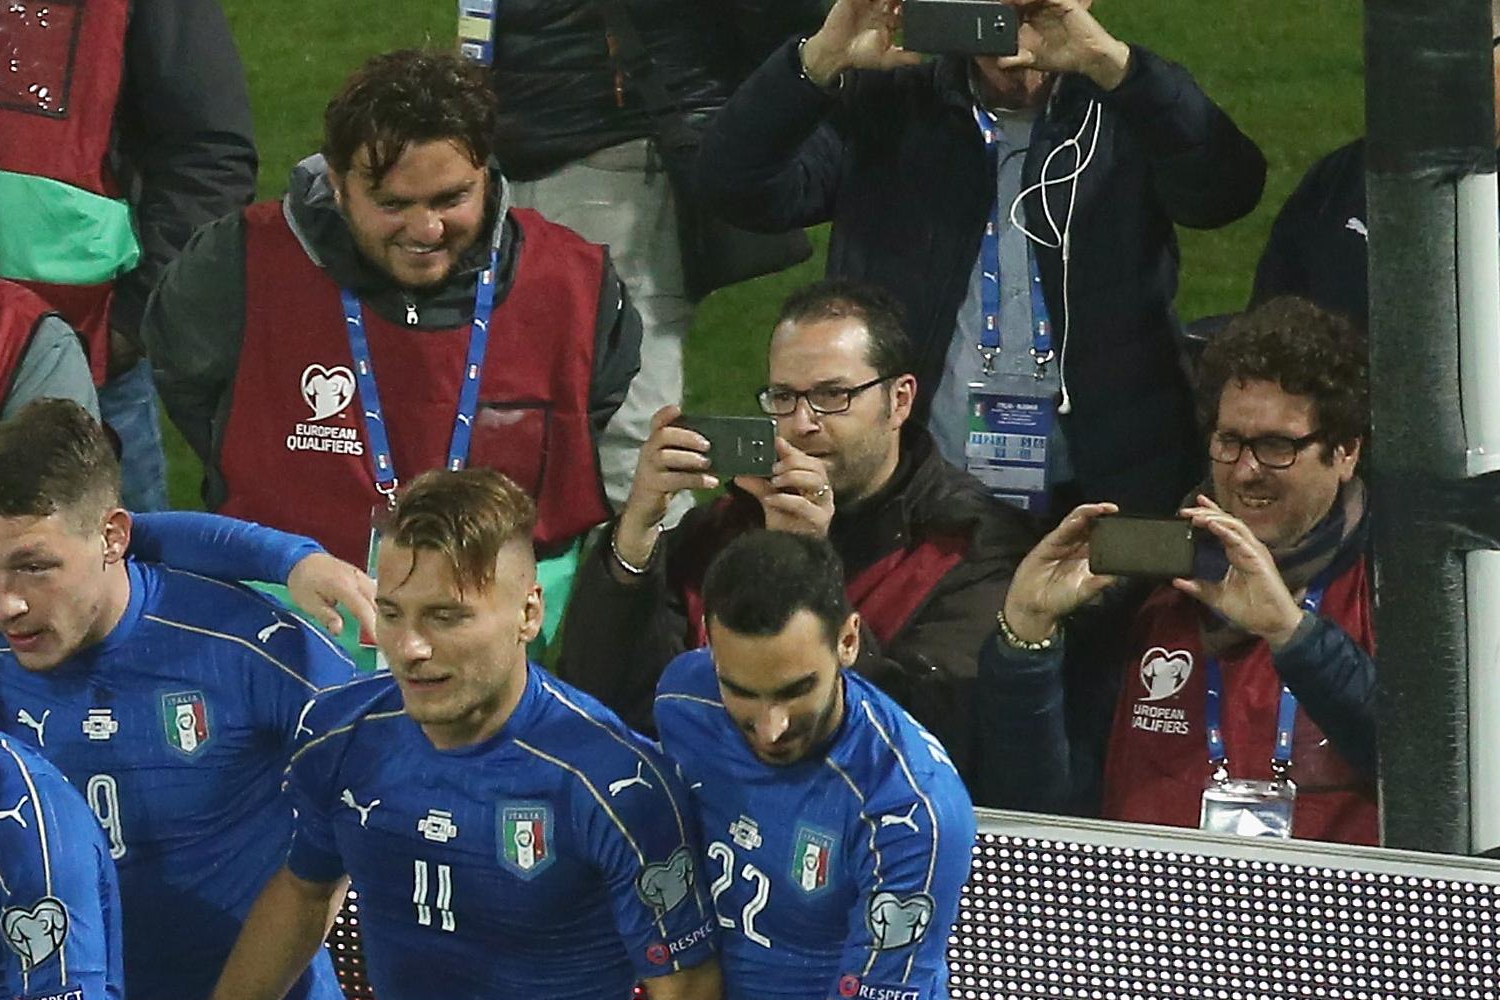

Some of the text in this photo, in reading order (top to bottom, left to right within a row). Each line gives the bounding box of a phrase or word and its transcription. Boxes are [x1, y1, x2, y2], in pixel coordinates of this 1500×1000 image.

[296, 423, 357, 440] EUROPEAN
[286, 435, 364, 456] QUALIFIERS
[1133, 704, 1185, 720] UROPEAN
[1132, 716, 1189, 735] ALIFIERS
[87, 774, 126, 860] 9
[508, 811, 541, 821] ITALIA
[413, 859, 457, 932] 11
[708, 841, 771, 948] 22
[669, 921, 714, 955] RESPEC
